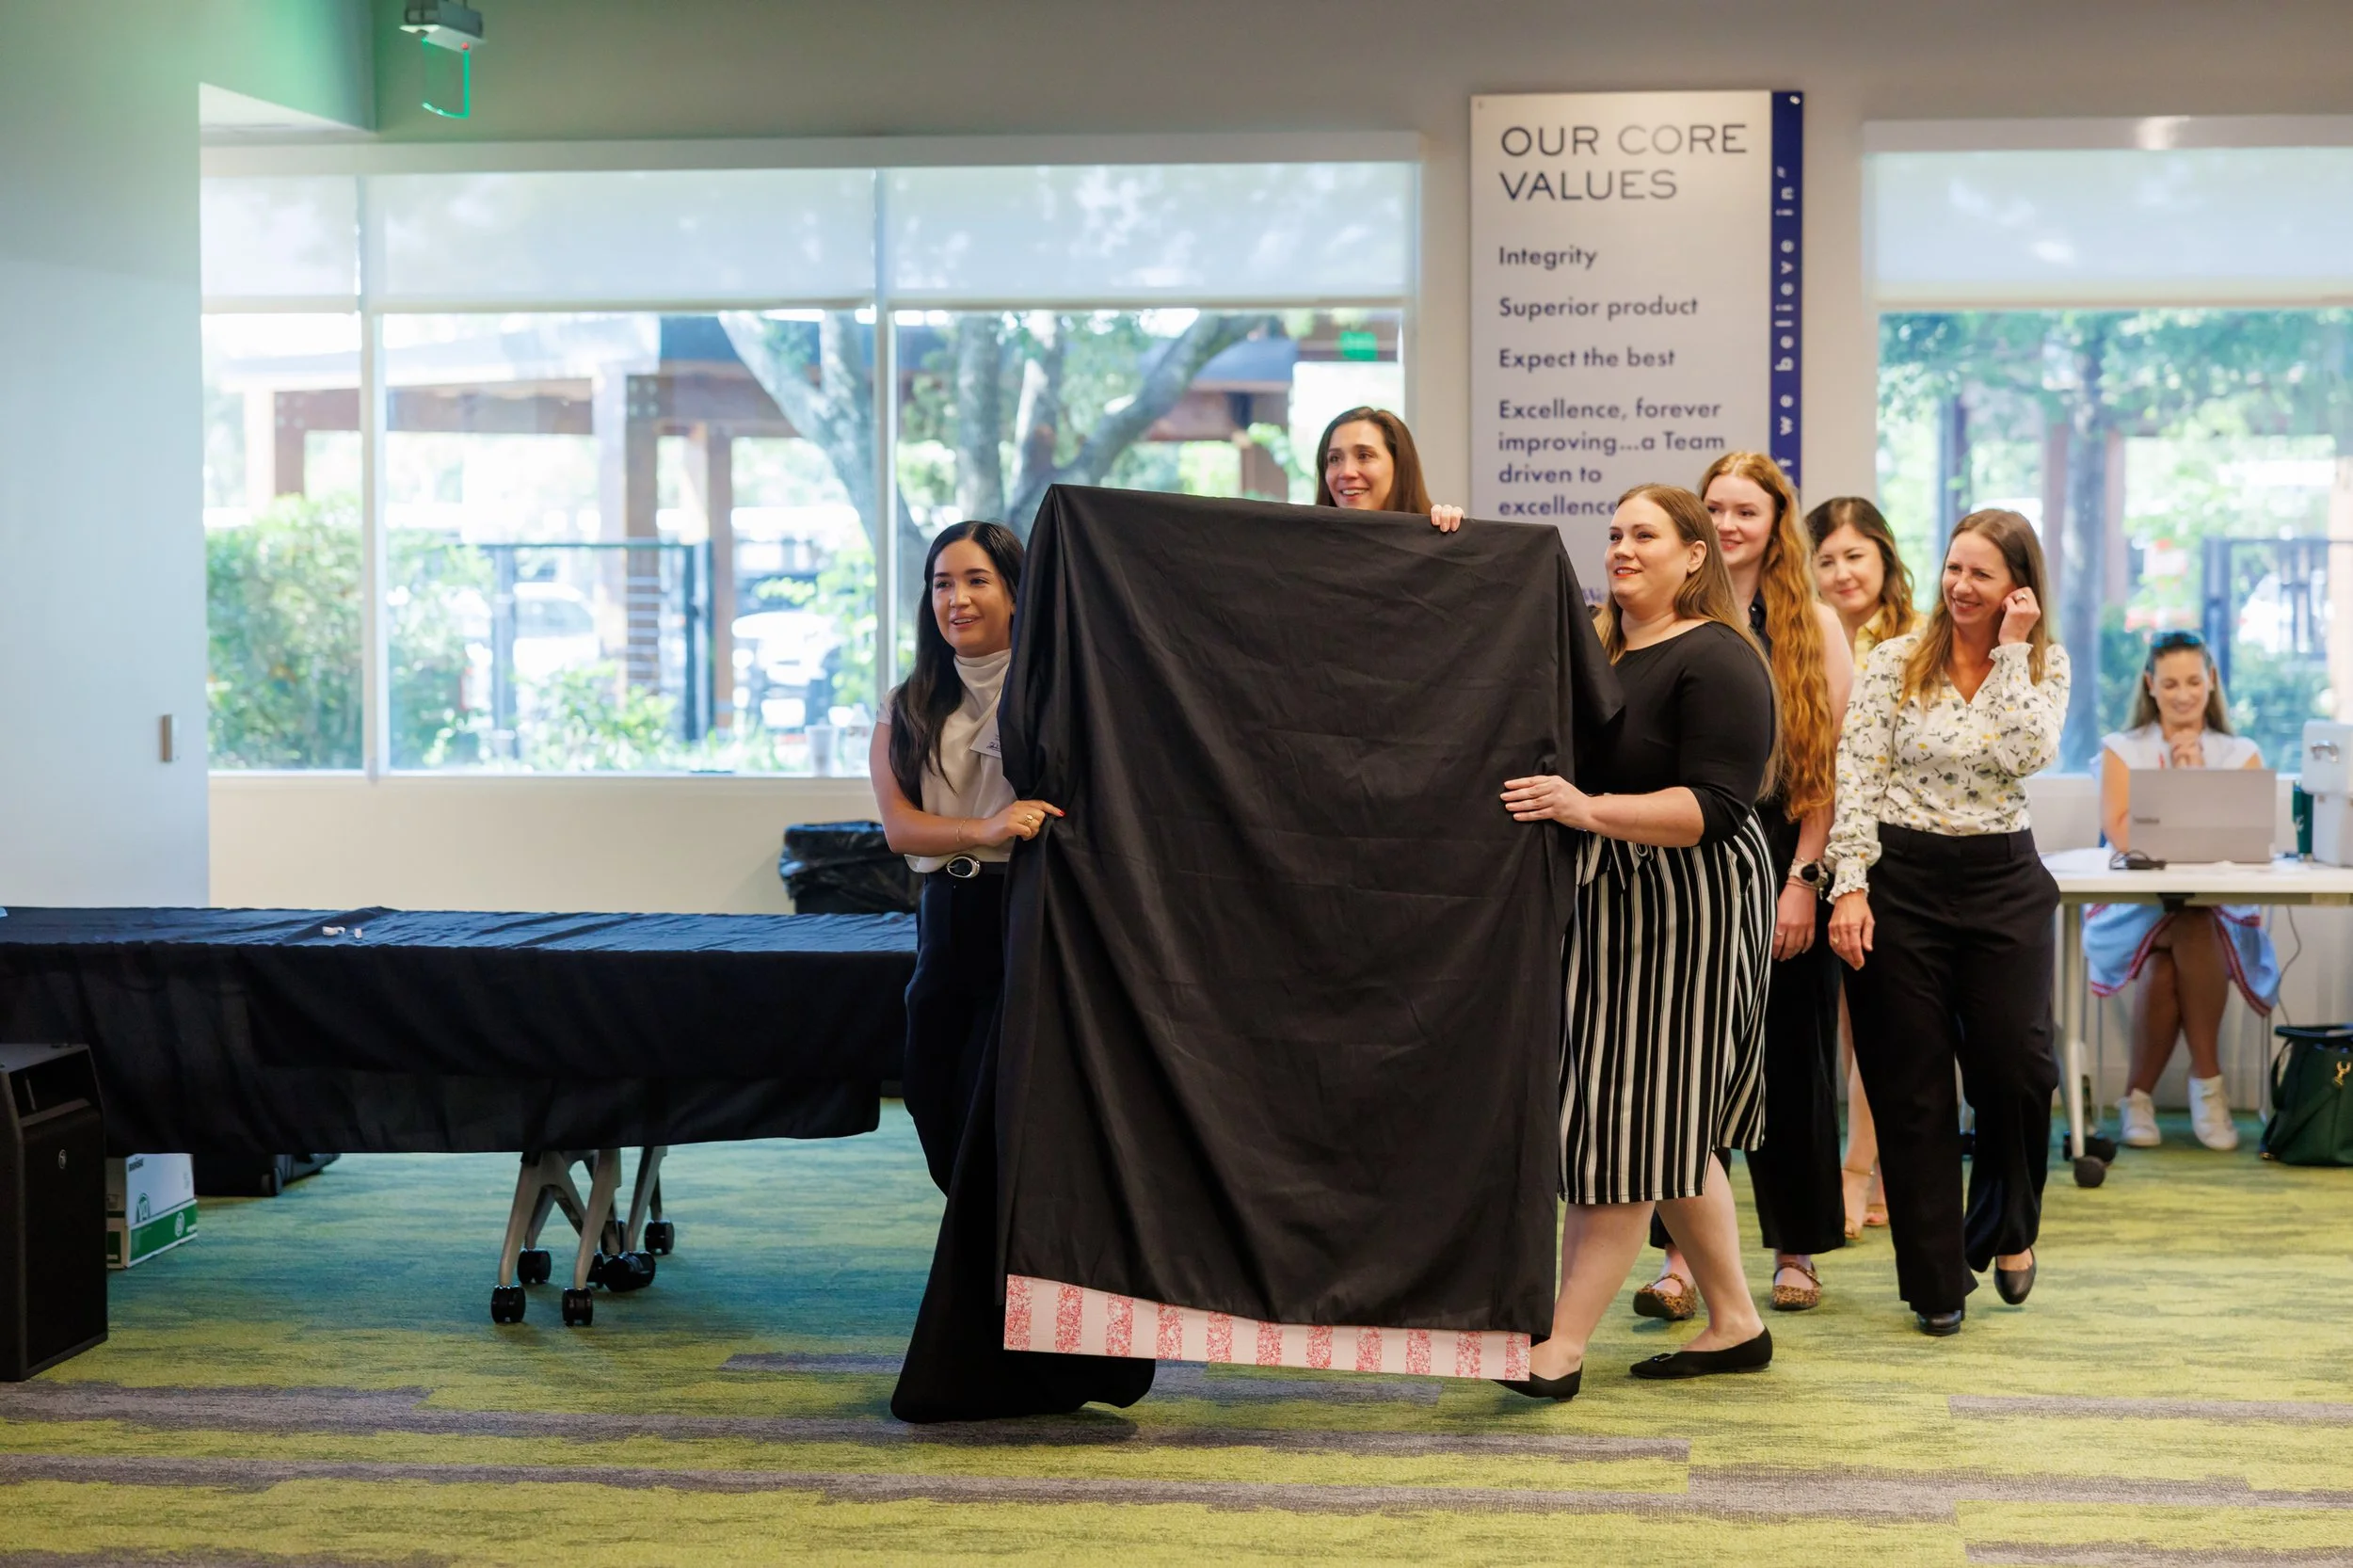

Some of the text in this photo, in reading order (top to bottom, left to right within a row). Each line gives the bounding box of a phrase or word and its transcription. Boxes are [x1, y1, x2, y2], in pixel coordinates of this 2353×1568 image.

[1499, 122, 1748, 157] OUR CORE
[1498, 168, 1678, 201] VALUES
[1498, 244, 1598, 271] Integrity
[1498, 294, 1699, 322] Superior product
[1774, 239, 1795, 372] believe
[1498, 346, 1675, 374] Expect the best
[1498, 396, 1721, 421] Excellence, forever
[1779, 393, 1794, 437] we
[1662, 430, 1725, 451] Team
[1497, 462, 1603, 484] driven to
